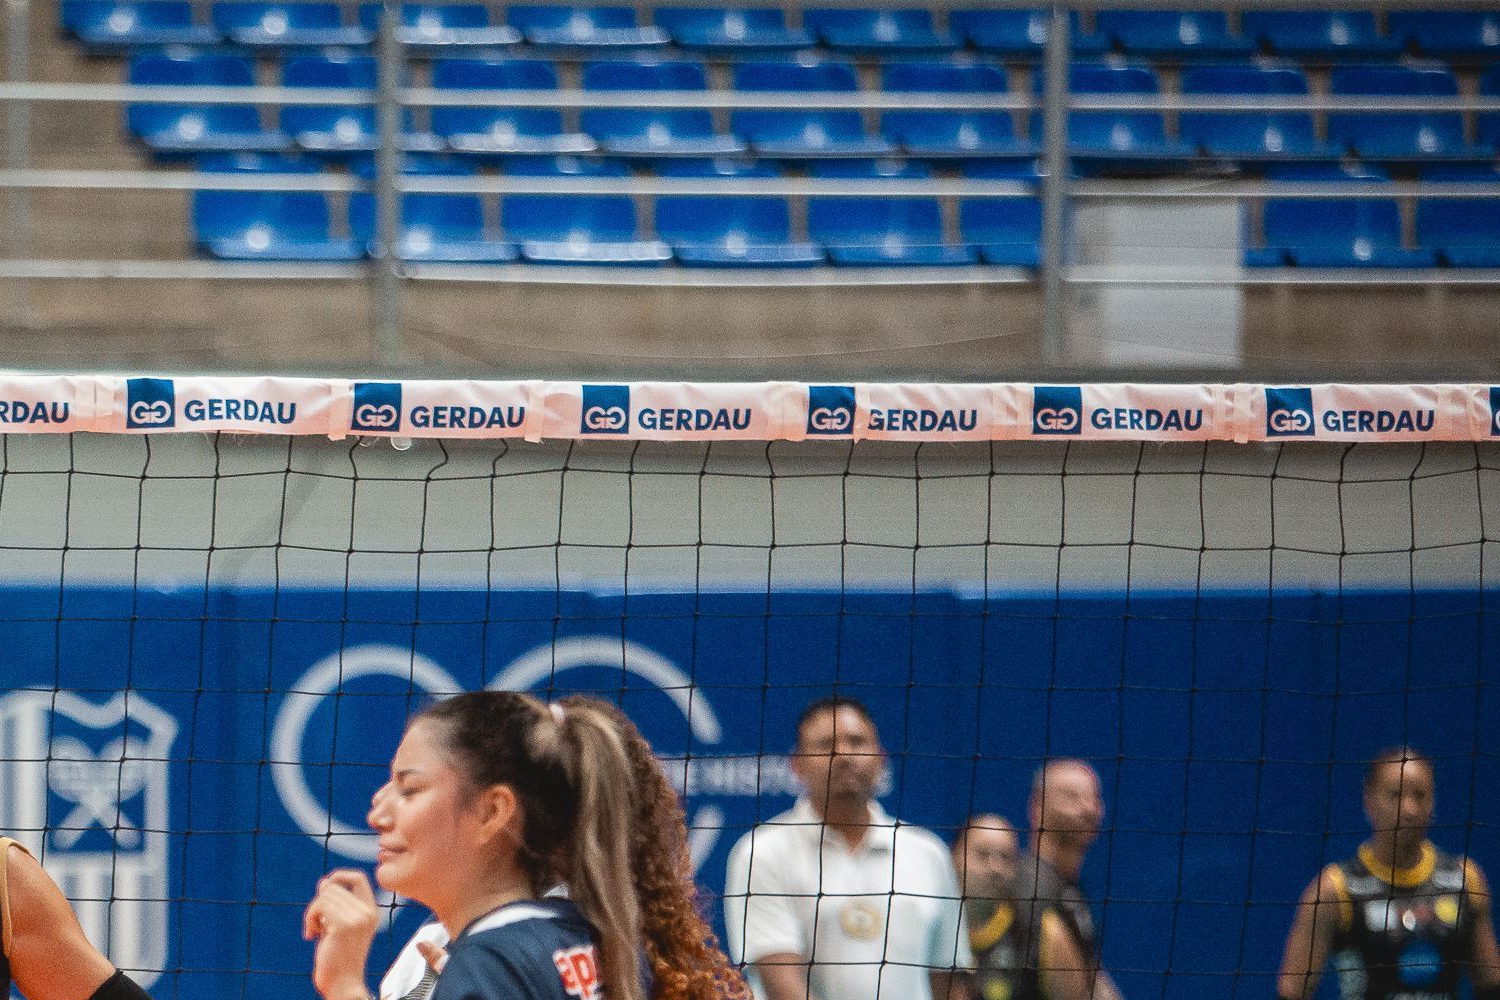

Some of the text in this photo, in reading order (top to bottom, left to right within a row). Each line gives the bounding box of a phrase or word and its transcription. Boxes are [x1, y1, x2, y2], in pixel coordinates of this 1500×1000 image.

[184, 398, 296, 425] GERDAU
[409, 405, 525, 429] GERDAU
[638, 408, 752, 431] GERDAU
[867, 409, 978, 432] GERDAU
[1090, 407, 1203, 432] GERDAU
[1322, 409, 1435, 433] GERDAU
